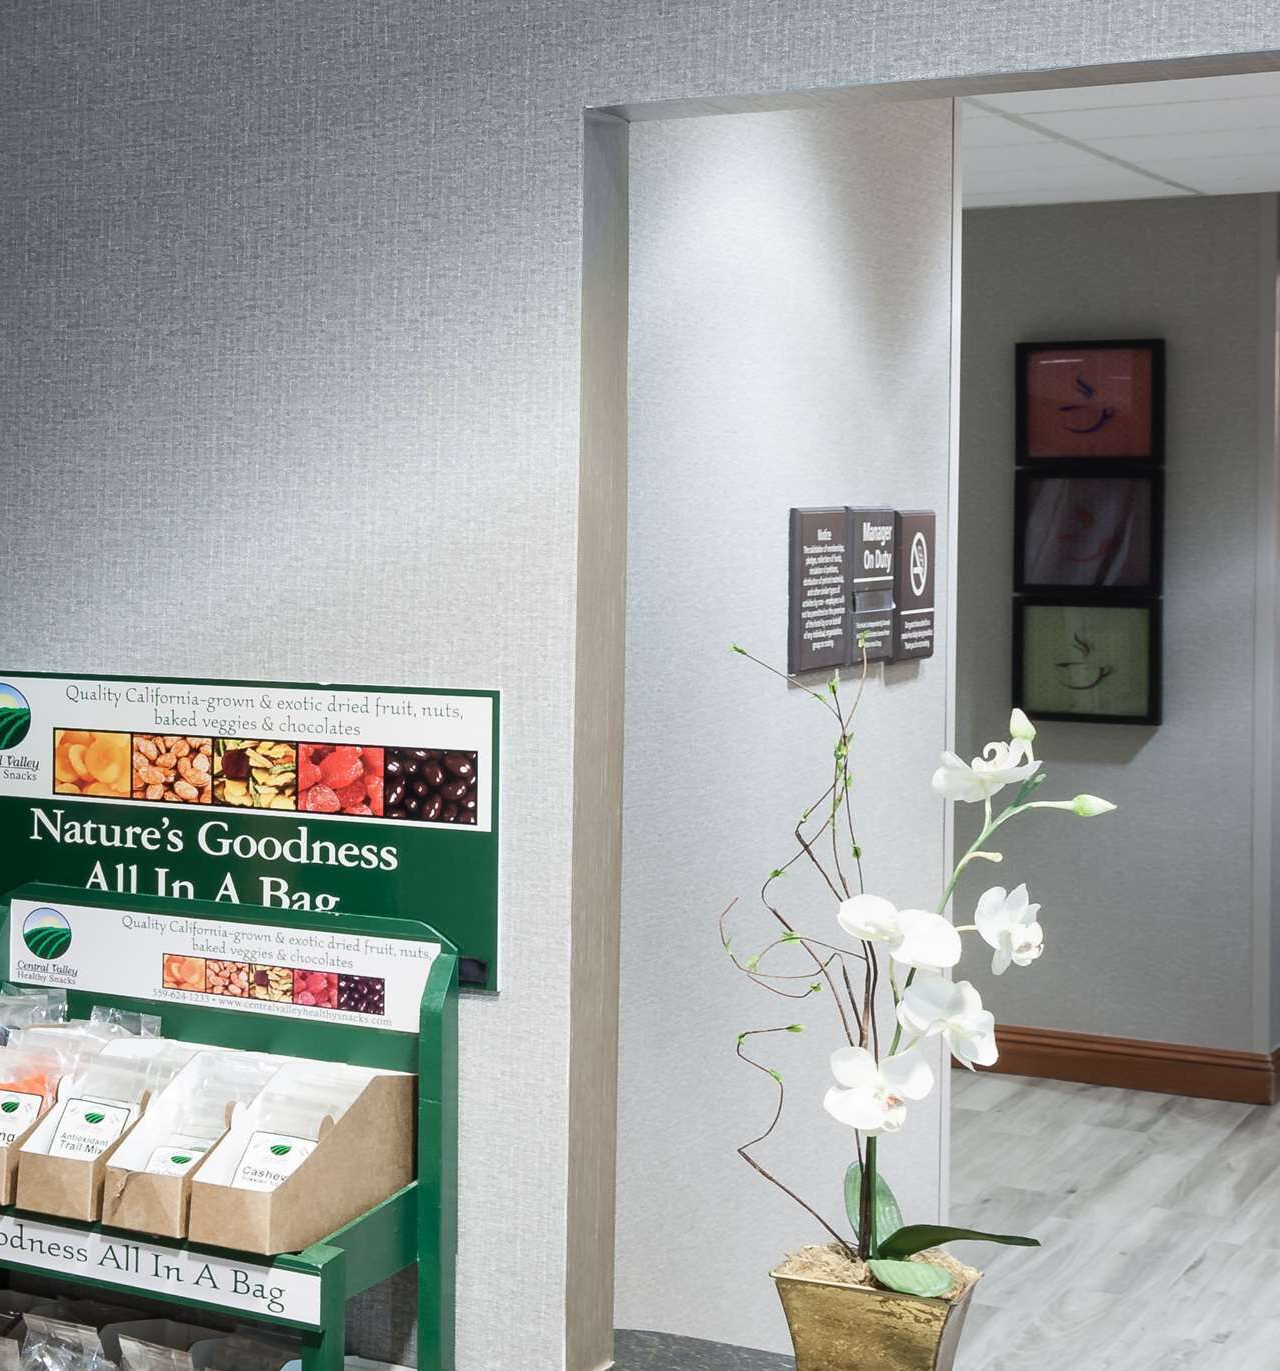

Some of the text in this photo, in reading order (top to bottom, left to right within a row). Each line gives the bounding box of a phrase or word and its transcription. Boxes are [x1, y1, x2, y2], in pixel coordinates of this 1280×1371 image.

[862, 522, 892, 546] Manager
[863, 549, 892, 573] On Duty
[65, 684, 464, 719] Quality California-grown & exotic dried fruit, nuts,
[154, 710, 361, 736] baked veggies & chocolates
[3, 769, 37, 781] Snacks
[7, 755, 40, 772] Valley
[30, 808, 398, 871] Nature's Goodness
[85, 860, 340, 916] All In A Bag
[121, 915, 432, 961] Quality California-grown & exotic dried fruit, nuts,
[192, 938, 353, 969] baked veggies & chocolates
[17, 960, 78, 977] Central Valley
[17, 971, 76, 985] Healthy Snacks
[60, 1141, 83, 1152] Trail
[98, 1244, 138, 1273] All
[152, 1253, 184, 1282] In
[193, 1262, 220, 1289] A
[232, 1269, 285, 1313] Bag
